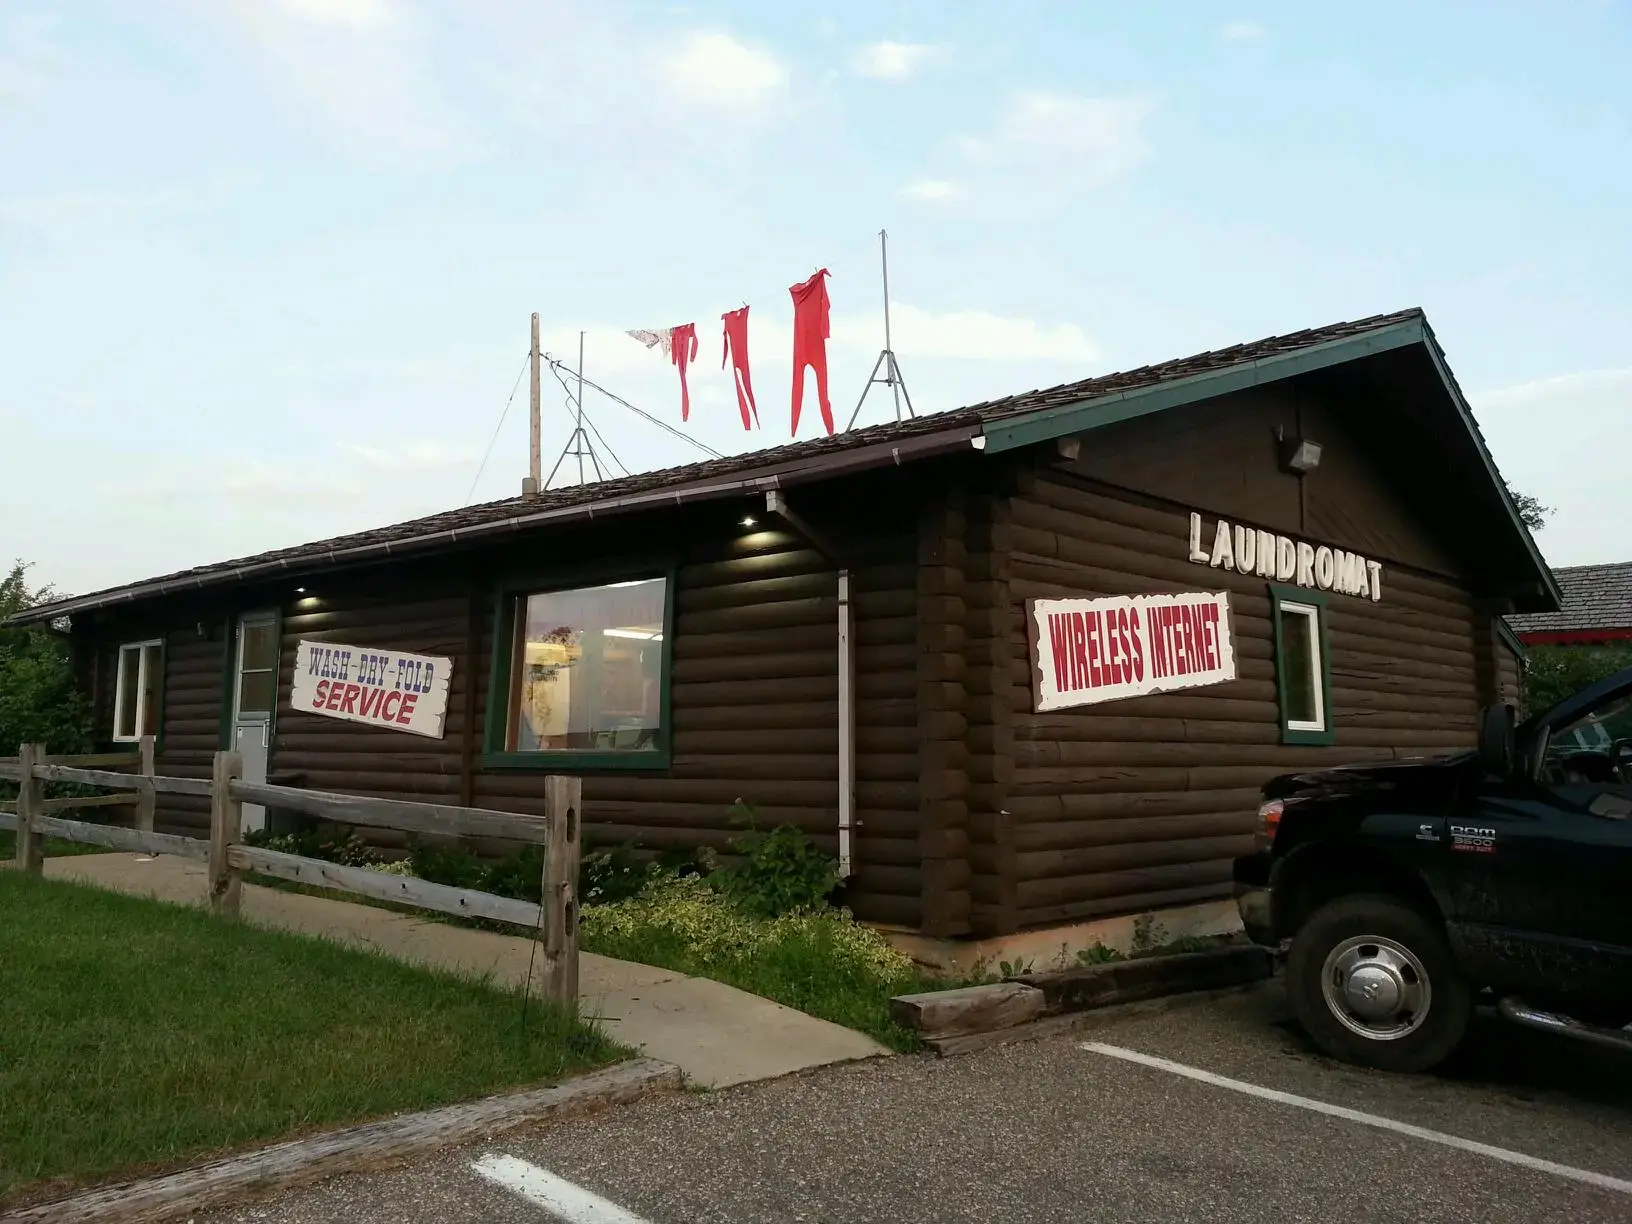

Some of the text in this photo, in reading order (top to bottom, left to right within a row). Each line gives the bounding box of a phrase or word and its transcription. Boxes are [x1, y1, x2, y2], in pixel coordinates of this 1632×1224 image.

[1189, 512, 1382, 602] LAUNDROMAT
[1048, 603, 1222, 693] WIRELESS INTERNET
[312, 679, 418, 725] SERVICE
